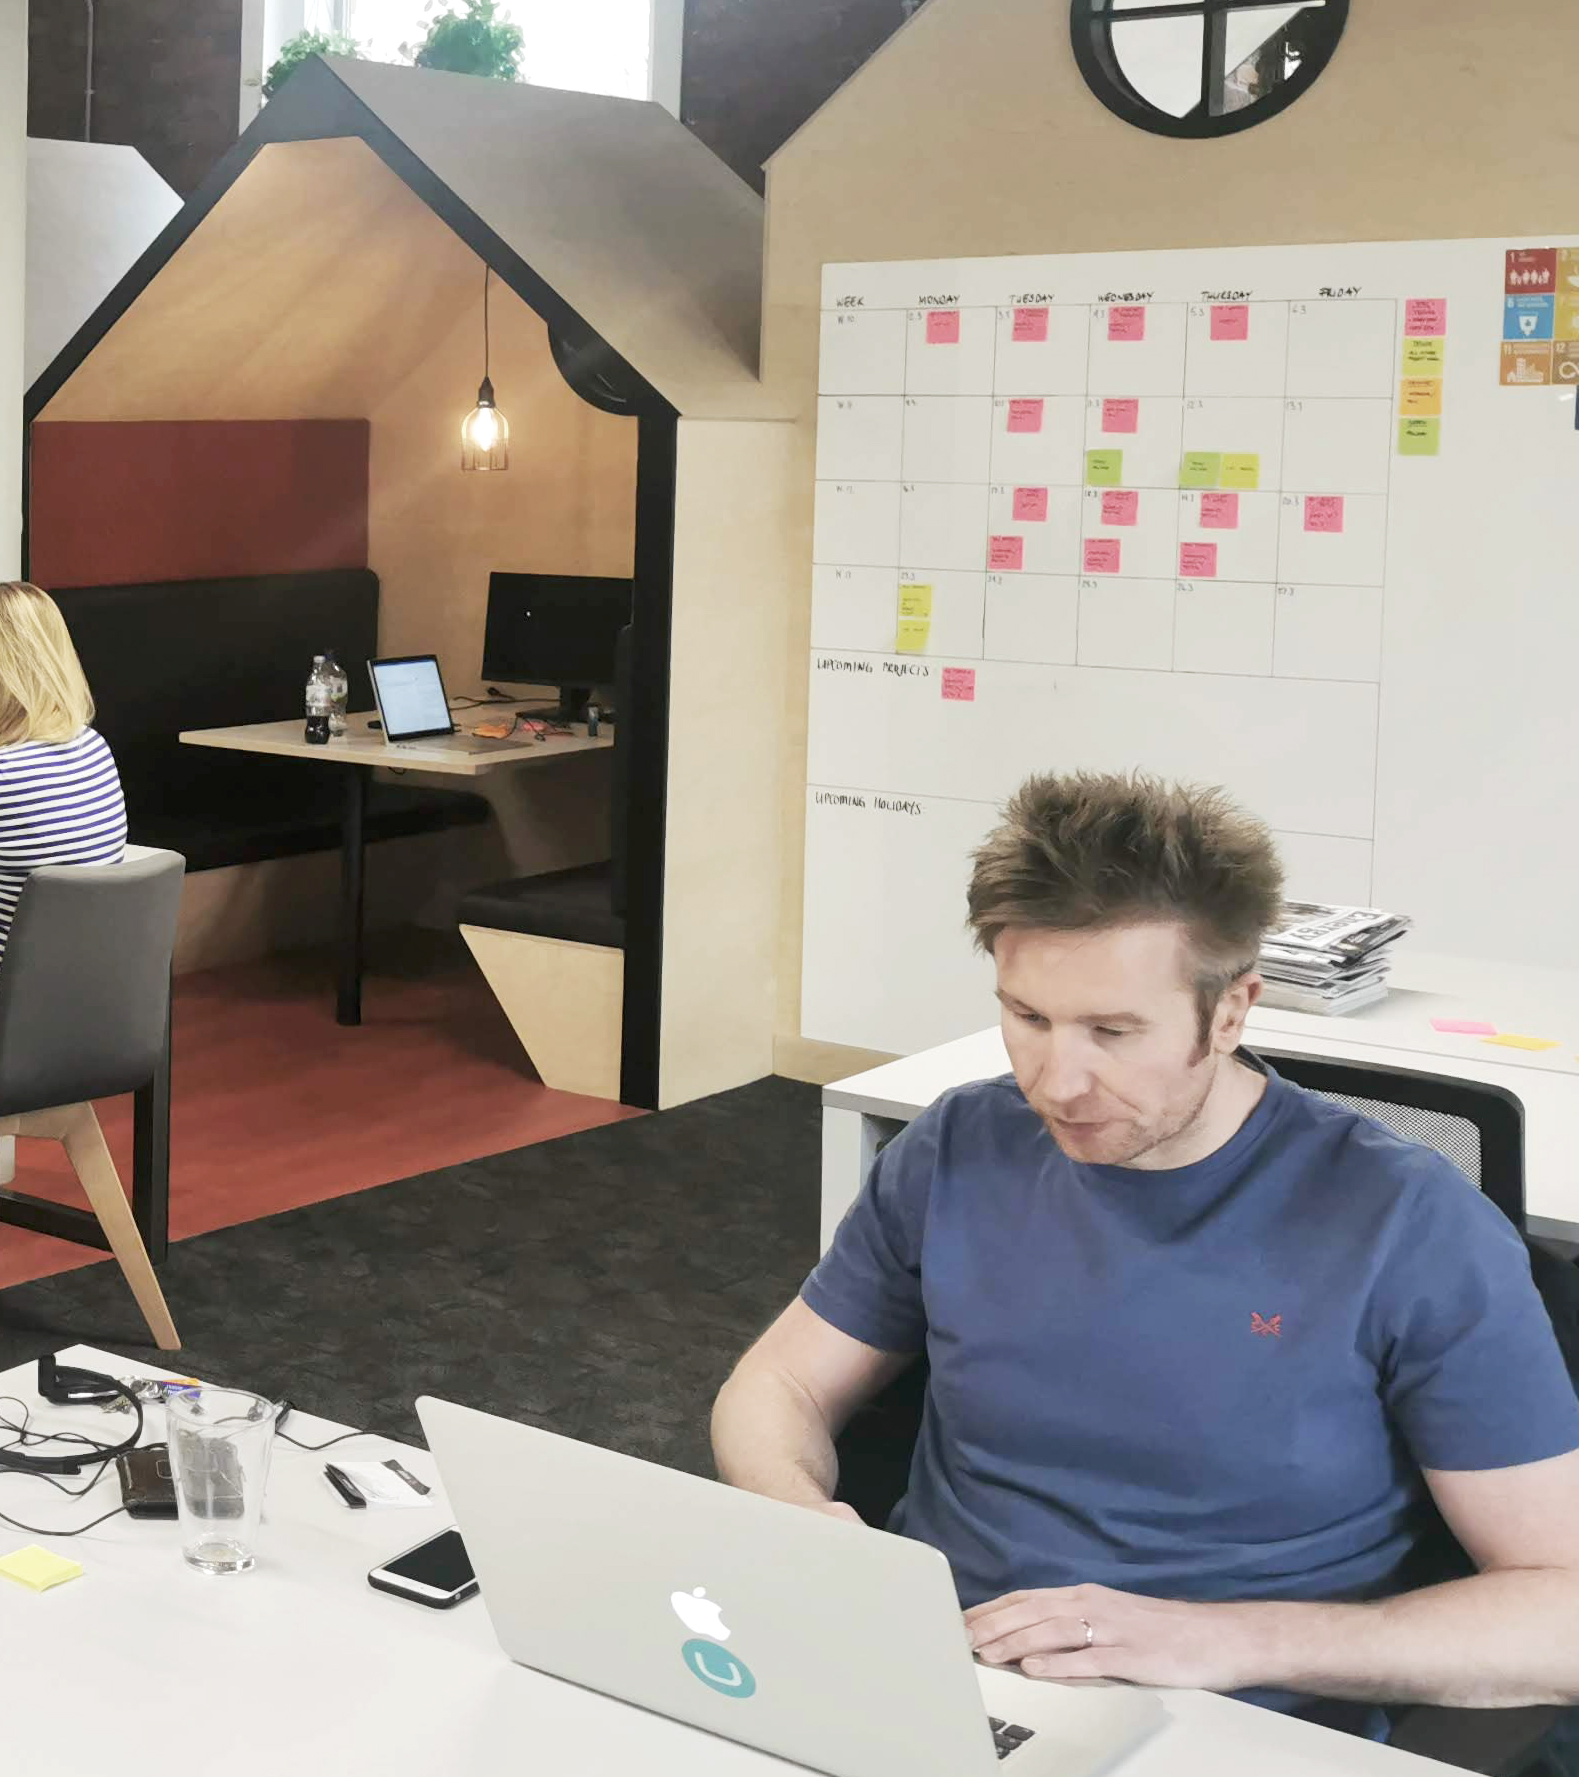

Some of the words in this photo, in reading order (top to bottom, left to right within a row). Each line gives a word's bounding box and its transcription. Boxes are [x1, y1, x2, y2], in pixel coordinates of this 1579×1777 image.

[835, 295, 866, 308] WEEK
[918, 294, 961, 306] MONDAY
[1009, 293, 1055, 305] TUESDAY
[1097, 291, 1155, 303] WEDNESDAY
[1200, 290, 1254, 301] THURSDAY
[1318, 287, 1362, 298] FRIDAY
[816, 657, 874, 674] UPCOMING
[881, 661, 930, 678] PROJECTS
[815, 791, 867, 808] UPCOMING
[874, 796, 922, 815] HOLIDAYS
